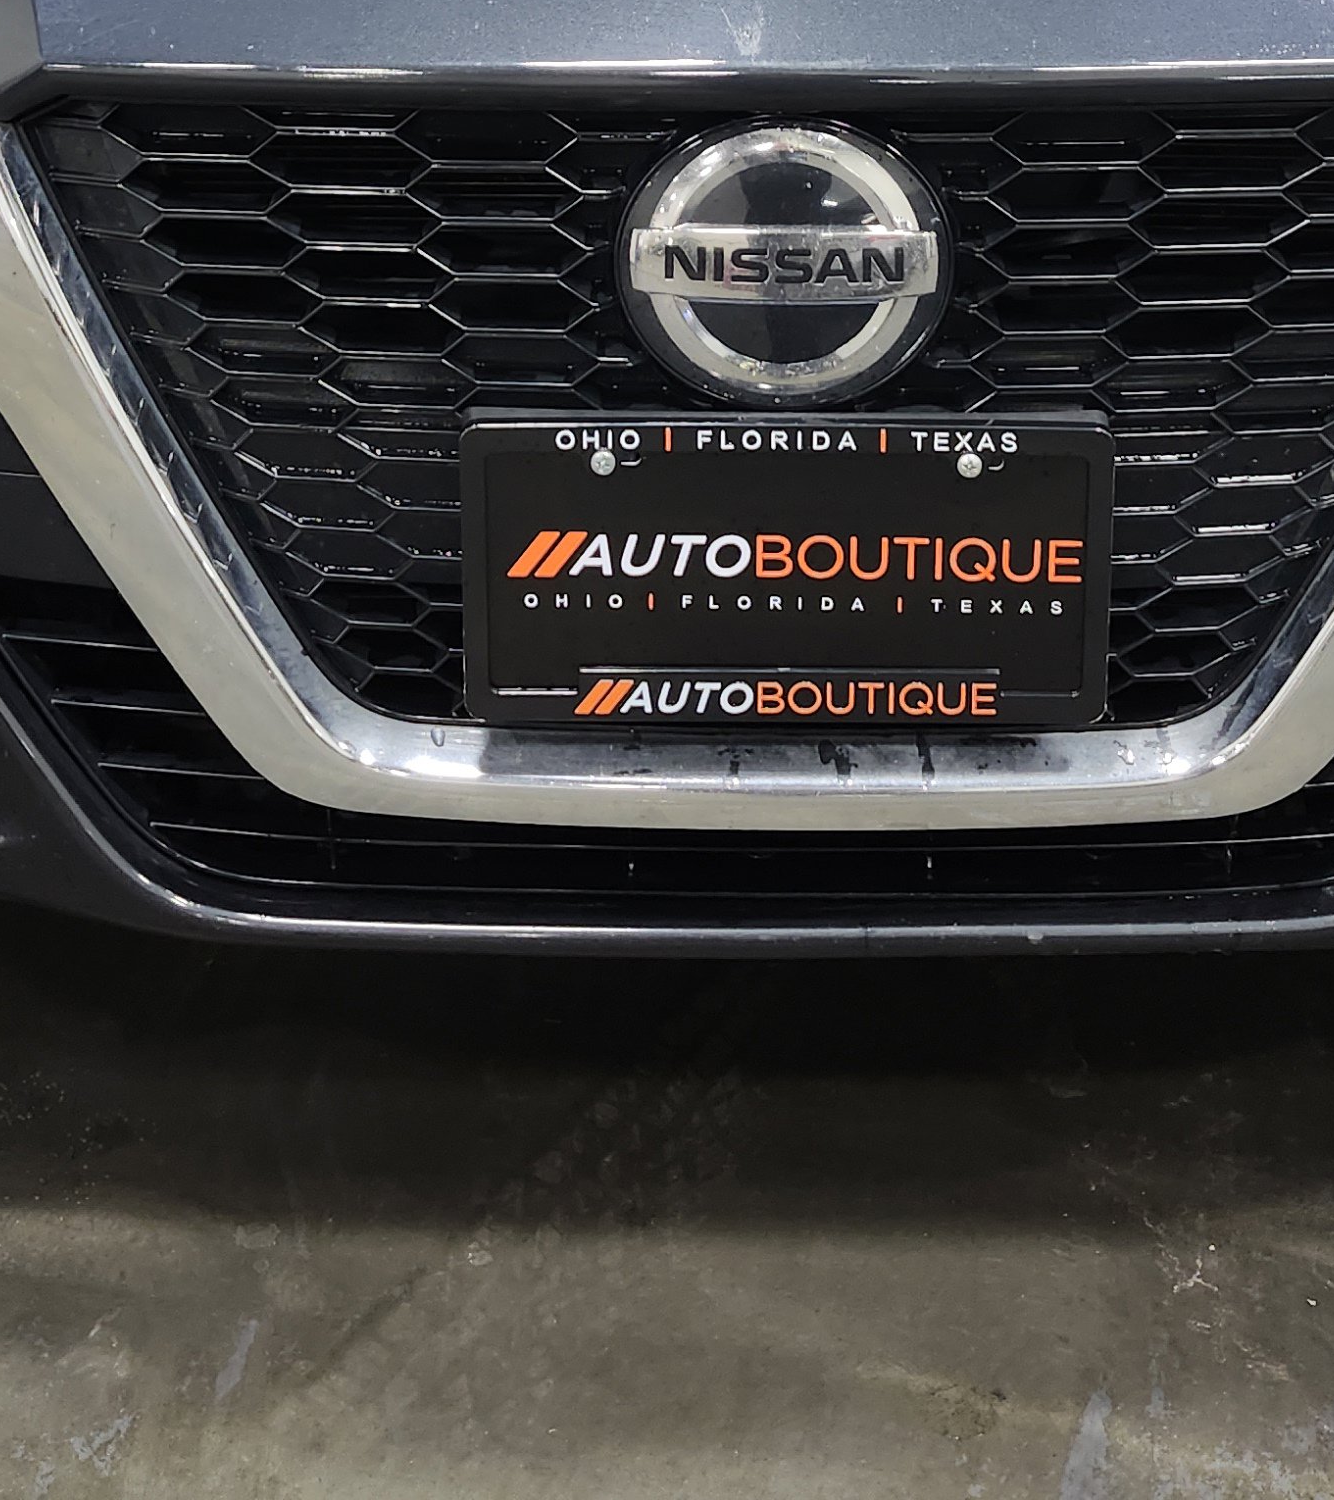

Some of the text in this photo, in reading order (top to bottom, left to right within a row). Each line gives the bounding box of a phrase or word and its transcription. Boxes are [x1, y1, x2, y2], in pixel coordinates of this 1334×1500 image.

[664, 244, 906, 285] NISSAN
[554, 429, 1019, 453] OHIO FLORIDA TEXAS
[522, 592, 1064, 616] OHIO FLORIDA TEXAS
